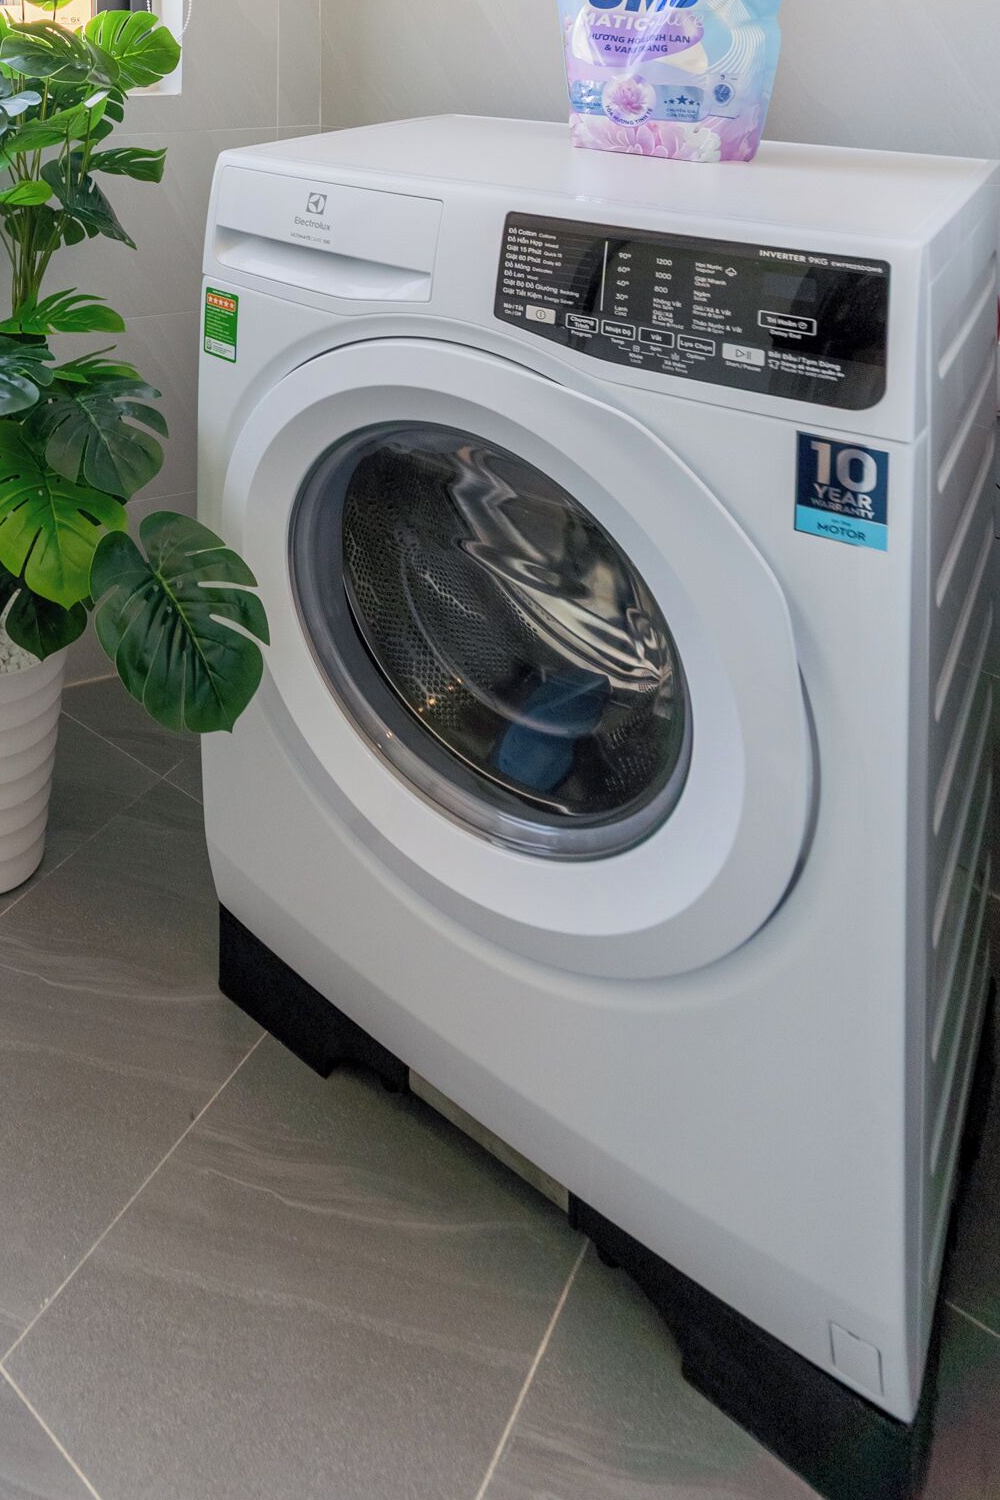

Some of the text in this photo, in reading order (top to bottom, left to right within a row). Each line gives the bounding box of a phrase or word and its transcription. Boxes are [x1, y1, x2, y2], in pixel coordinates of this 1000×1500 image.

[669, 34, 691, 43] LAN
[294, 216, 331, 230] Electrolux
[518, 229, 537, 237] Cotton
[528, 246, 542, 255] Phút
[527, 255, 541, 264] Phút
[656, 258, 672, 266] 1200
[759, 249, 807, 263] INVERTER
[808, 256, 828, 266] 9KG
[655, 271, 672, 280] 1000
[654, 285, 668, 294] 800
[570, 315, 595, 327] Chương
[605, 325, 621, 335] Nhiệt
[694, 341, 713, 352] Chọn
[810, 440, 877, 493] 10
[813, 483, 873, 511] YEAR
[810, 497, 875, 519] WARRANTY
[816, 522, 866, 541] MOTOR
